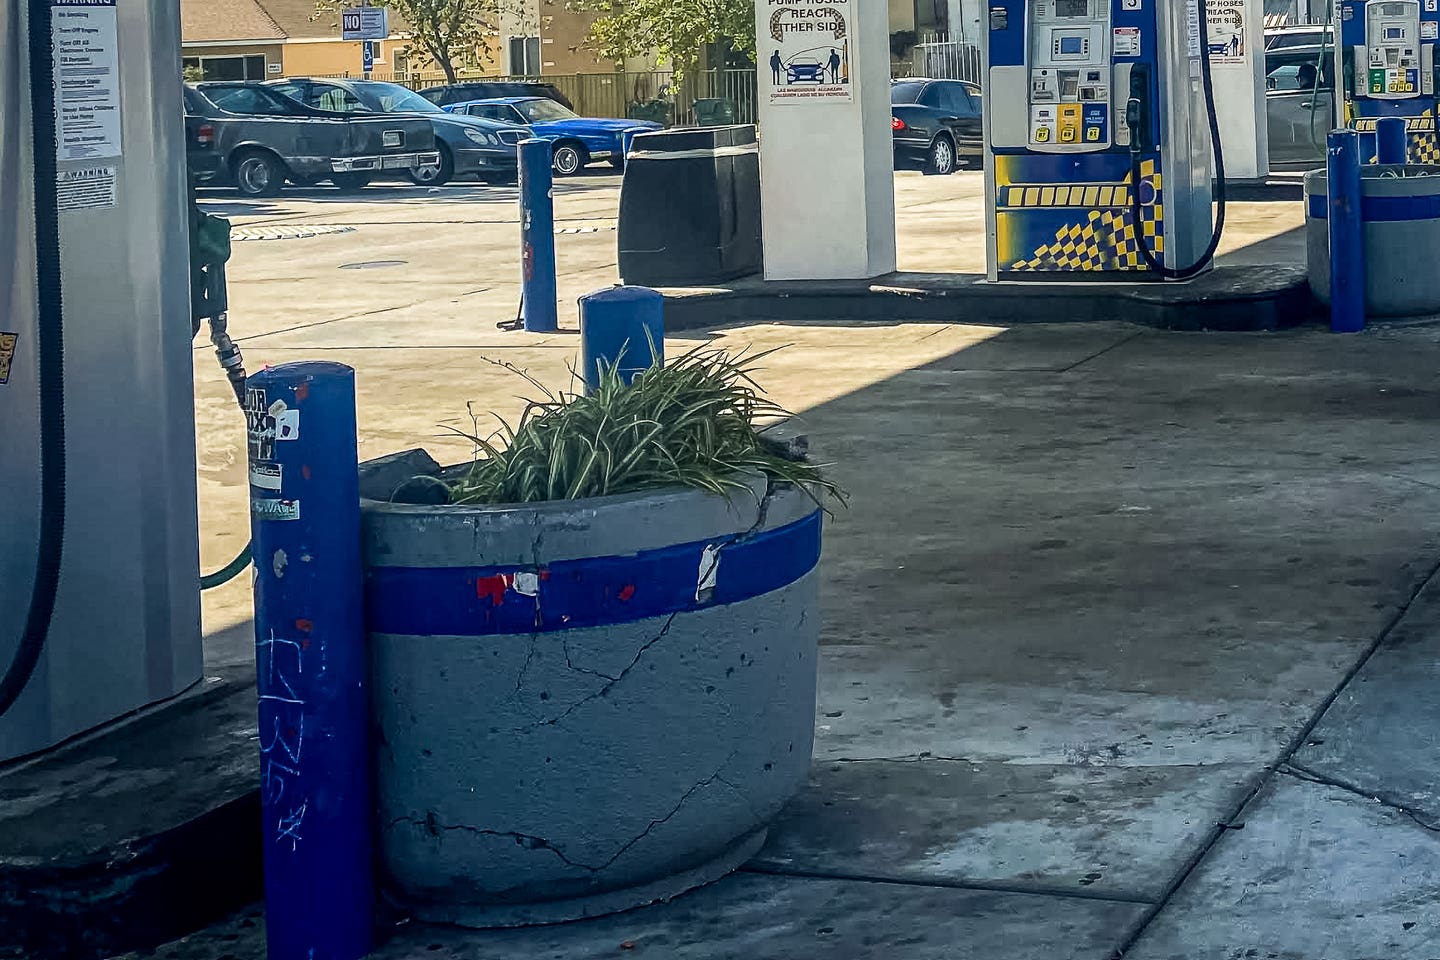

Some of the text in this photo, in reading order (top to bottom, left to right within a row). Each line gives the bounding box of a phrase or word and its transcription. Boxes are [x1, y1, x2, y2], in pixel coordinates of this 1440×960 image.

[1427, 0, 1435, 10] 5
[791, 8, 833, 19] REACH
[344, 15, 360, 29] NO
[772, 22, 846, 33] EITHER SIDE
